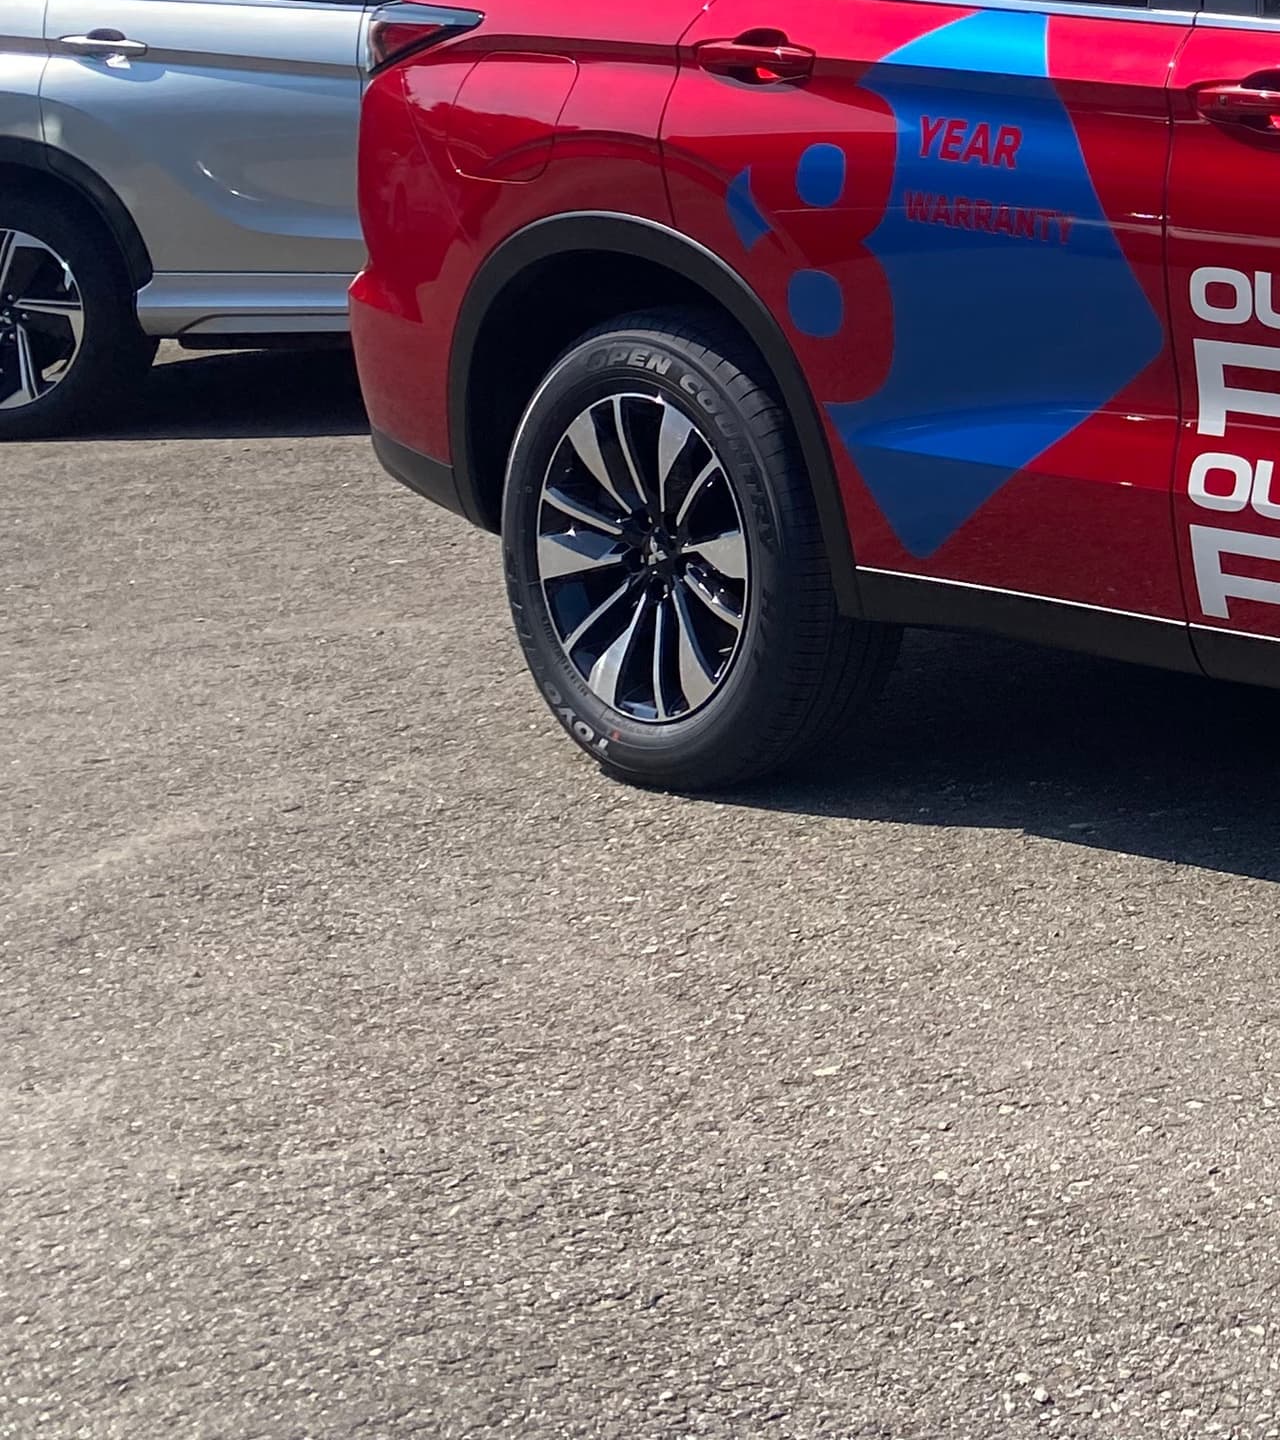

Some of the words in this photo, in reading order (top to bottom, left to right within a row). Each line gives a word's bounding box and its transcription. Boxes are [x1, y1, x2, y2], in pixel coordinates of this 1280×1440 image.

[919, 115, 1023, 170] YEAR
[904, 190, 1075, 245] WARRANTY
[585, 347, 672, 376] OPEN
